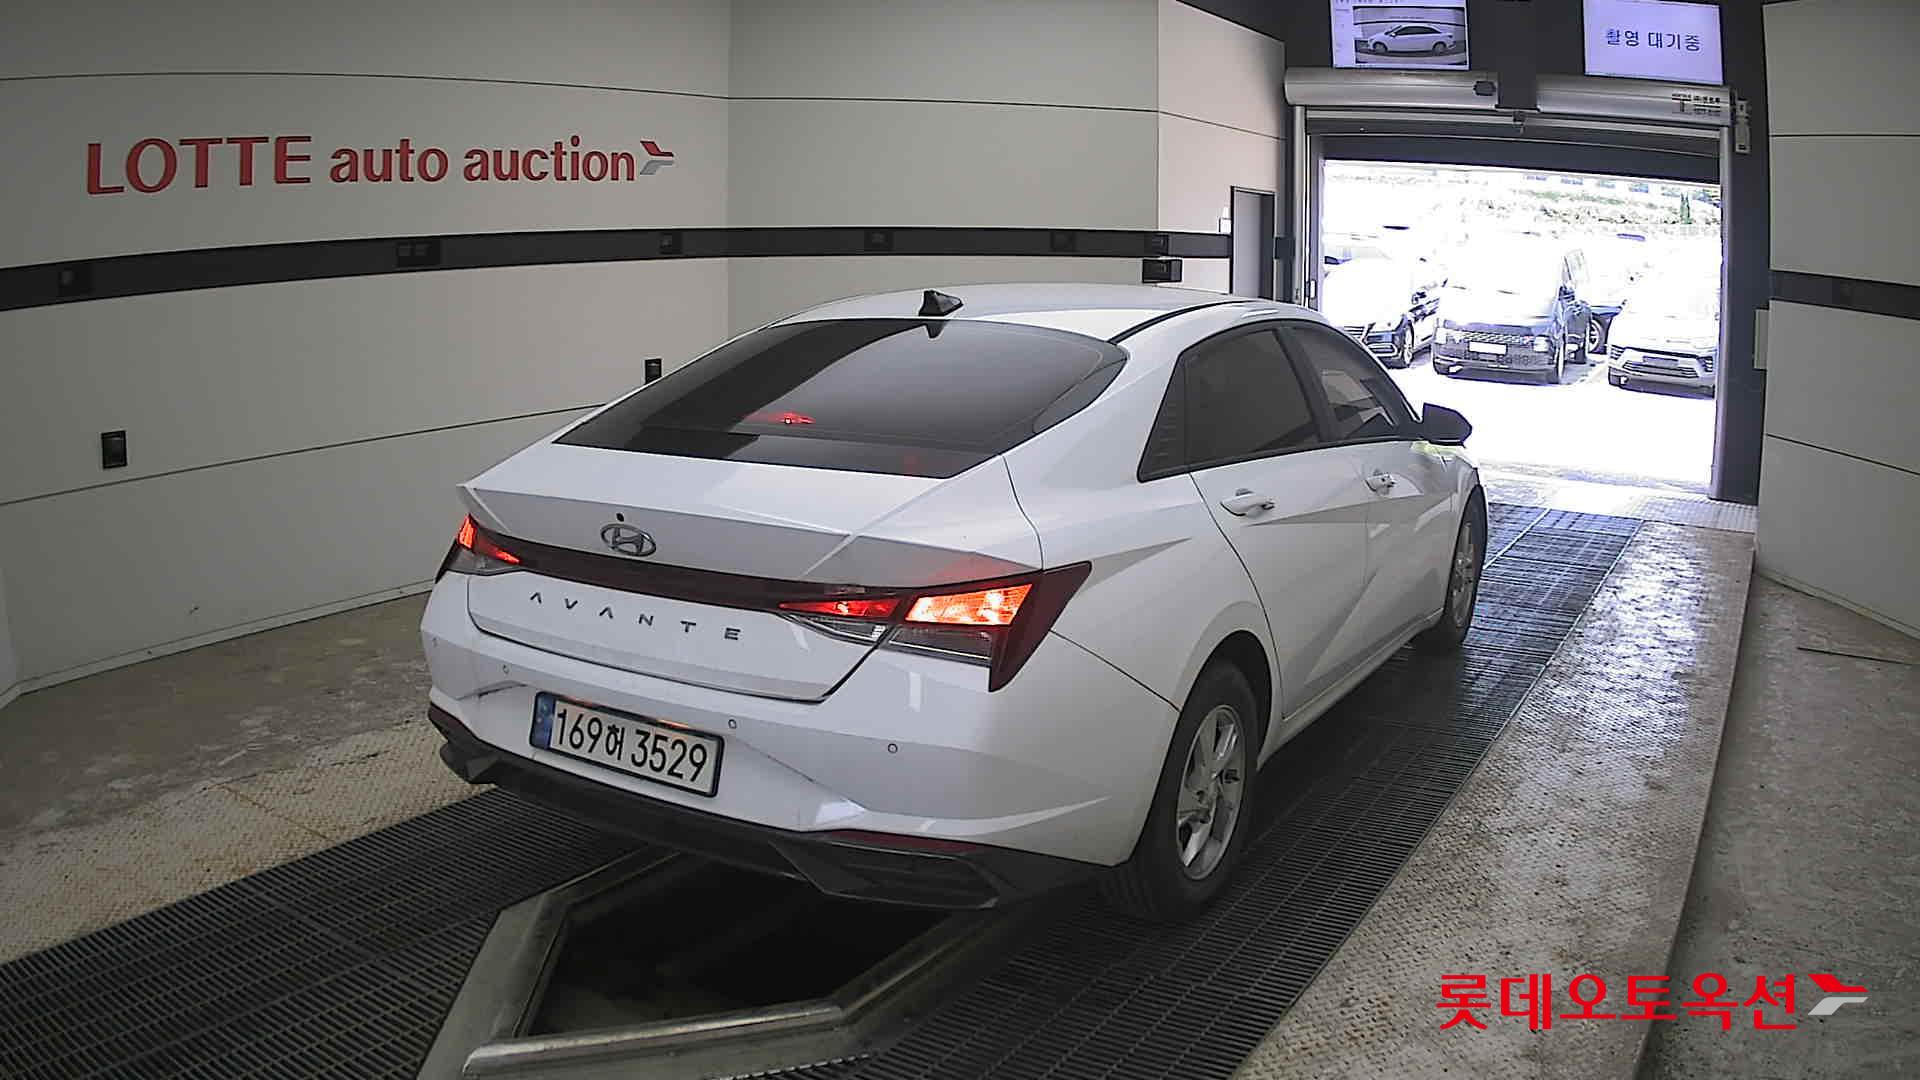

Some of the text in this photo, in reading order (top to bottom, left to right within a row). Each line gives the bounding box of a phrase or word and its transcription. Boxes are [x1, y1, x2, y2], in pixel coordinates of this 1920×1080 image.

[1607, 28, 1701, 52] 촬영 대기중
[86, 135, 635, 195] LOTTE auto auction
[530, 591, 741, 641] AVANTE
[557, 708, 708, 783] 169허 3529
